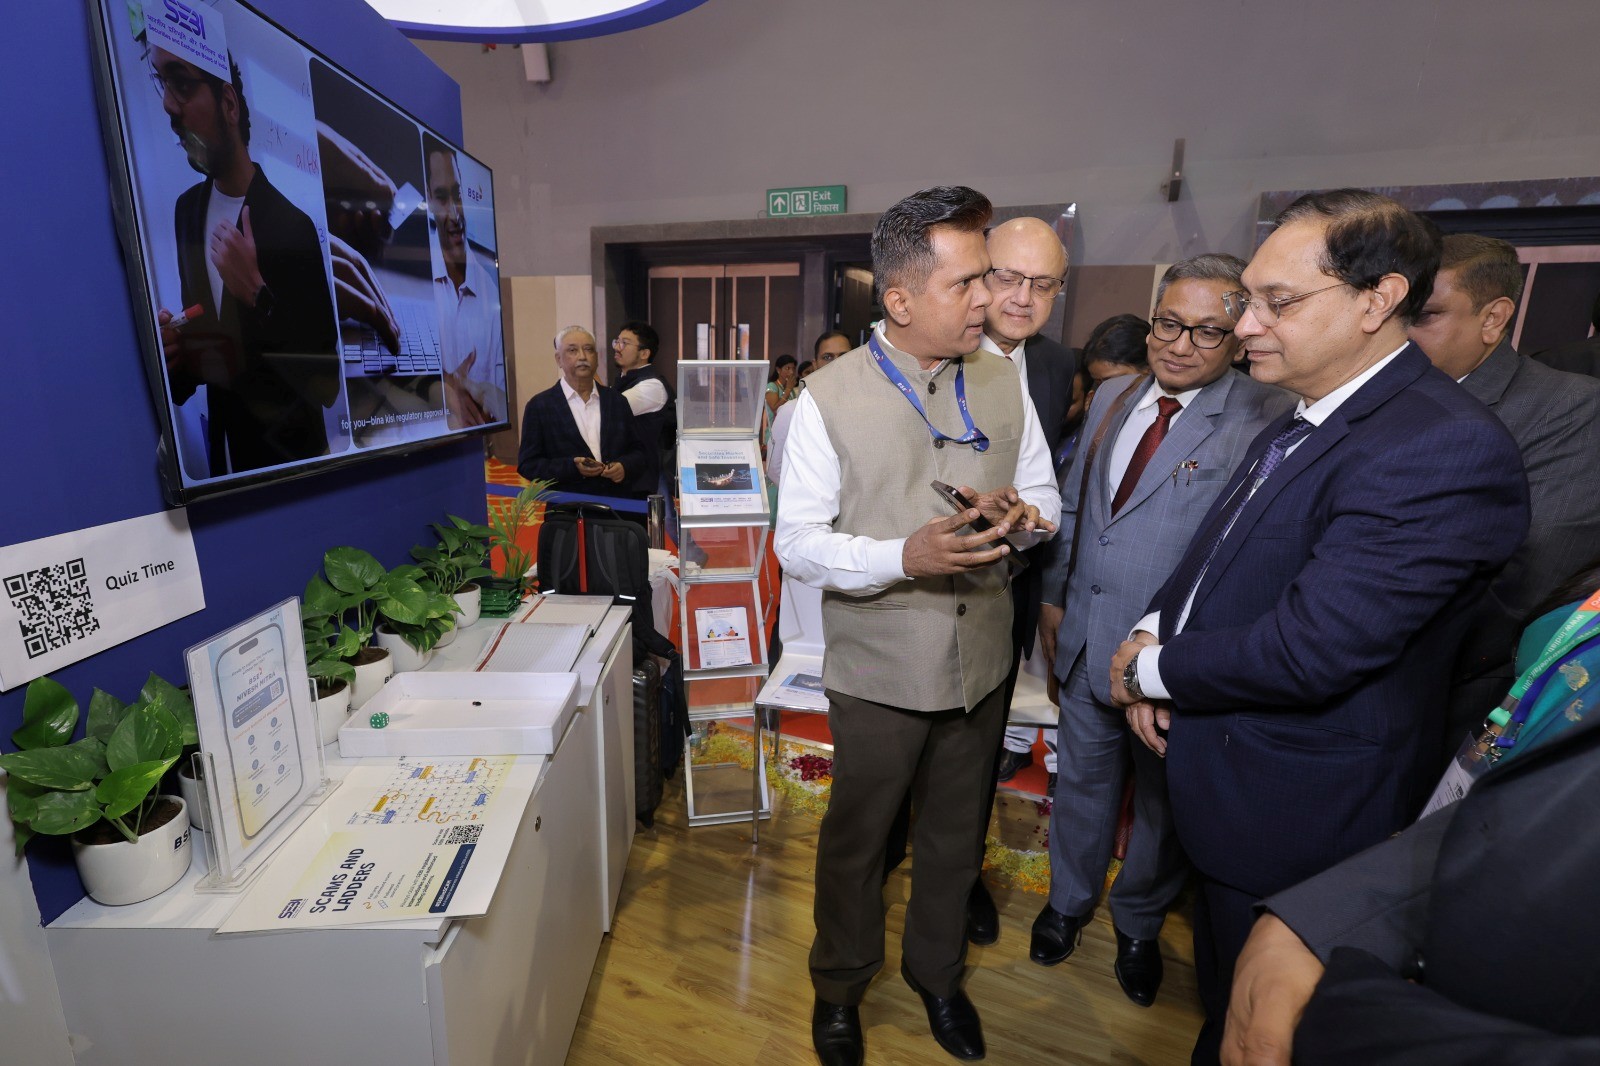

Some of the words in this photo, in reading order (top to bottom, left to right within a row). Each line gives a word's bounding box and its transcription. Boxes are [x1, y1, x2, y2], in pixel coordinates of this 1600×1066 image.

[467, 187, 479, 202] BSE
[812, 190, 832, 201] Exit
[813, 202, 839, 213] निकास
[341, 419, 351, 430] for
[385, 413, 395, 424] kisi
[396, 410, 423, 424] regulatory
[423, 408, 444, 419] approval
[105, 570, 140, 590] Quiz
[140, 560, 175, 579] Time
[236, 683, 259, 702] NIVESH
[259, 671, 276, 687] MITRA
[309, 873, 348, 914] SCAMS
[340, 848, 364, 870] AND
[332, 862, 376, 912] LADDERS
